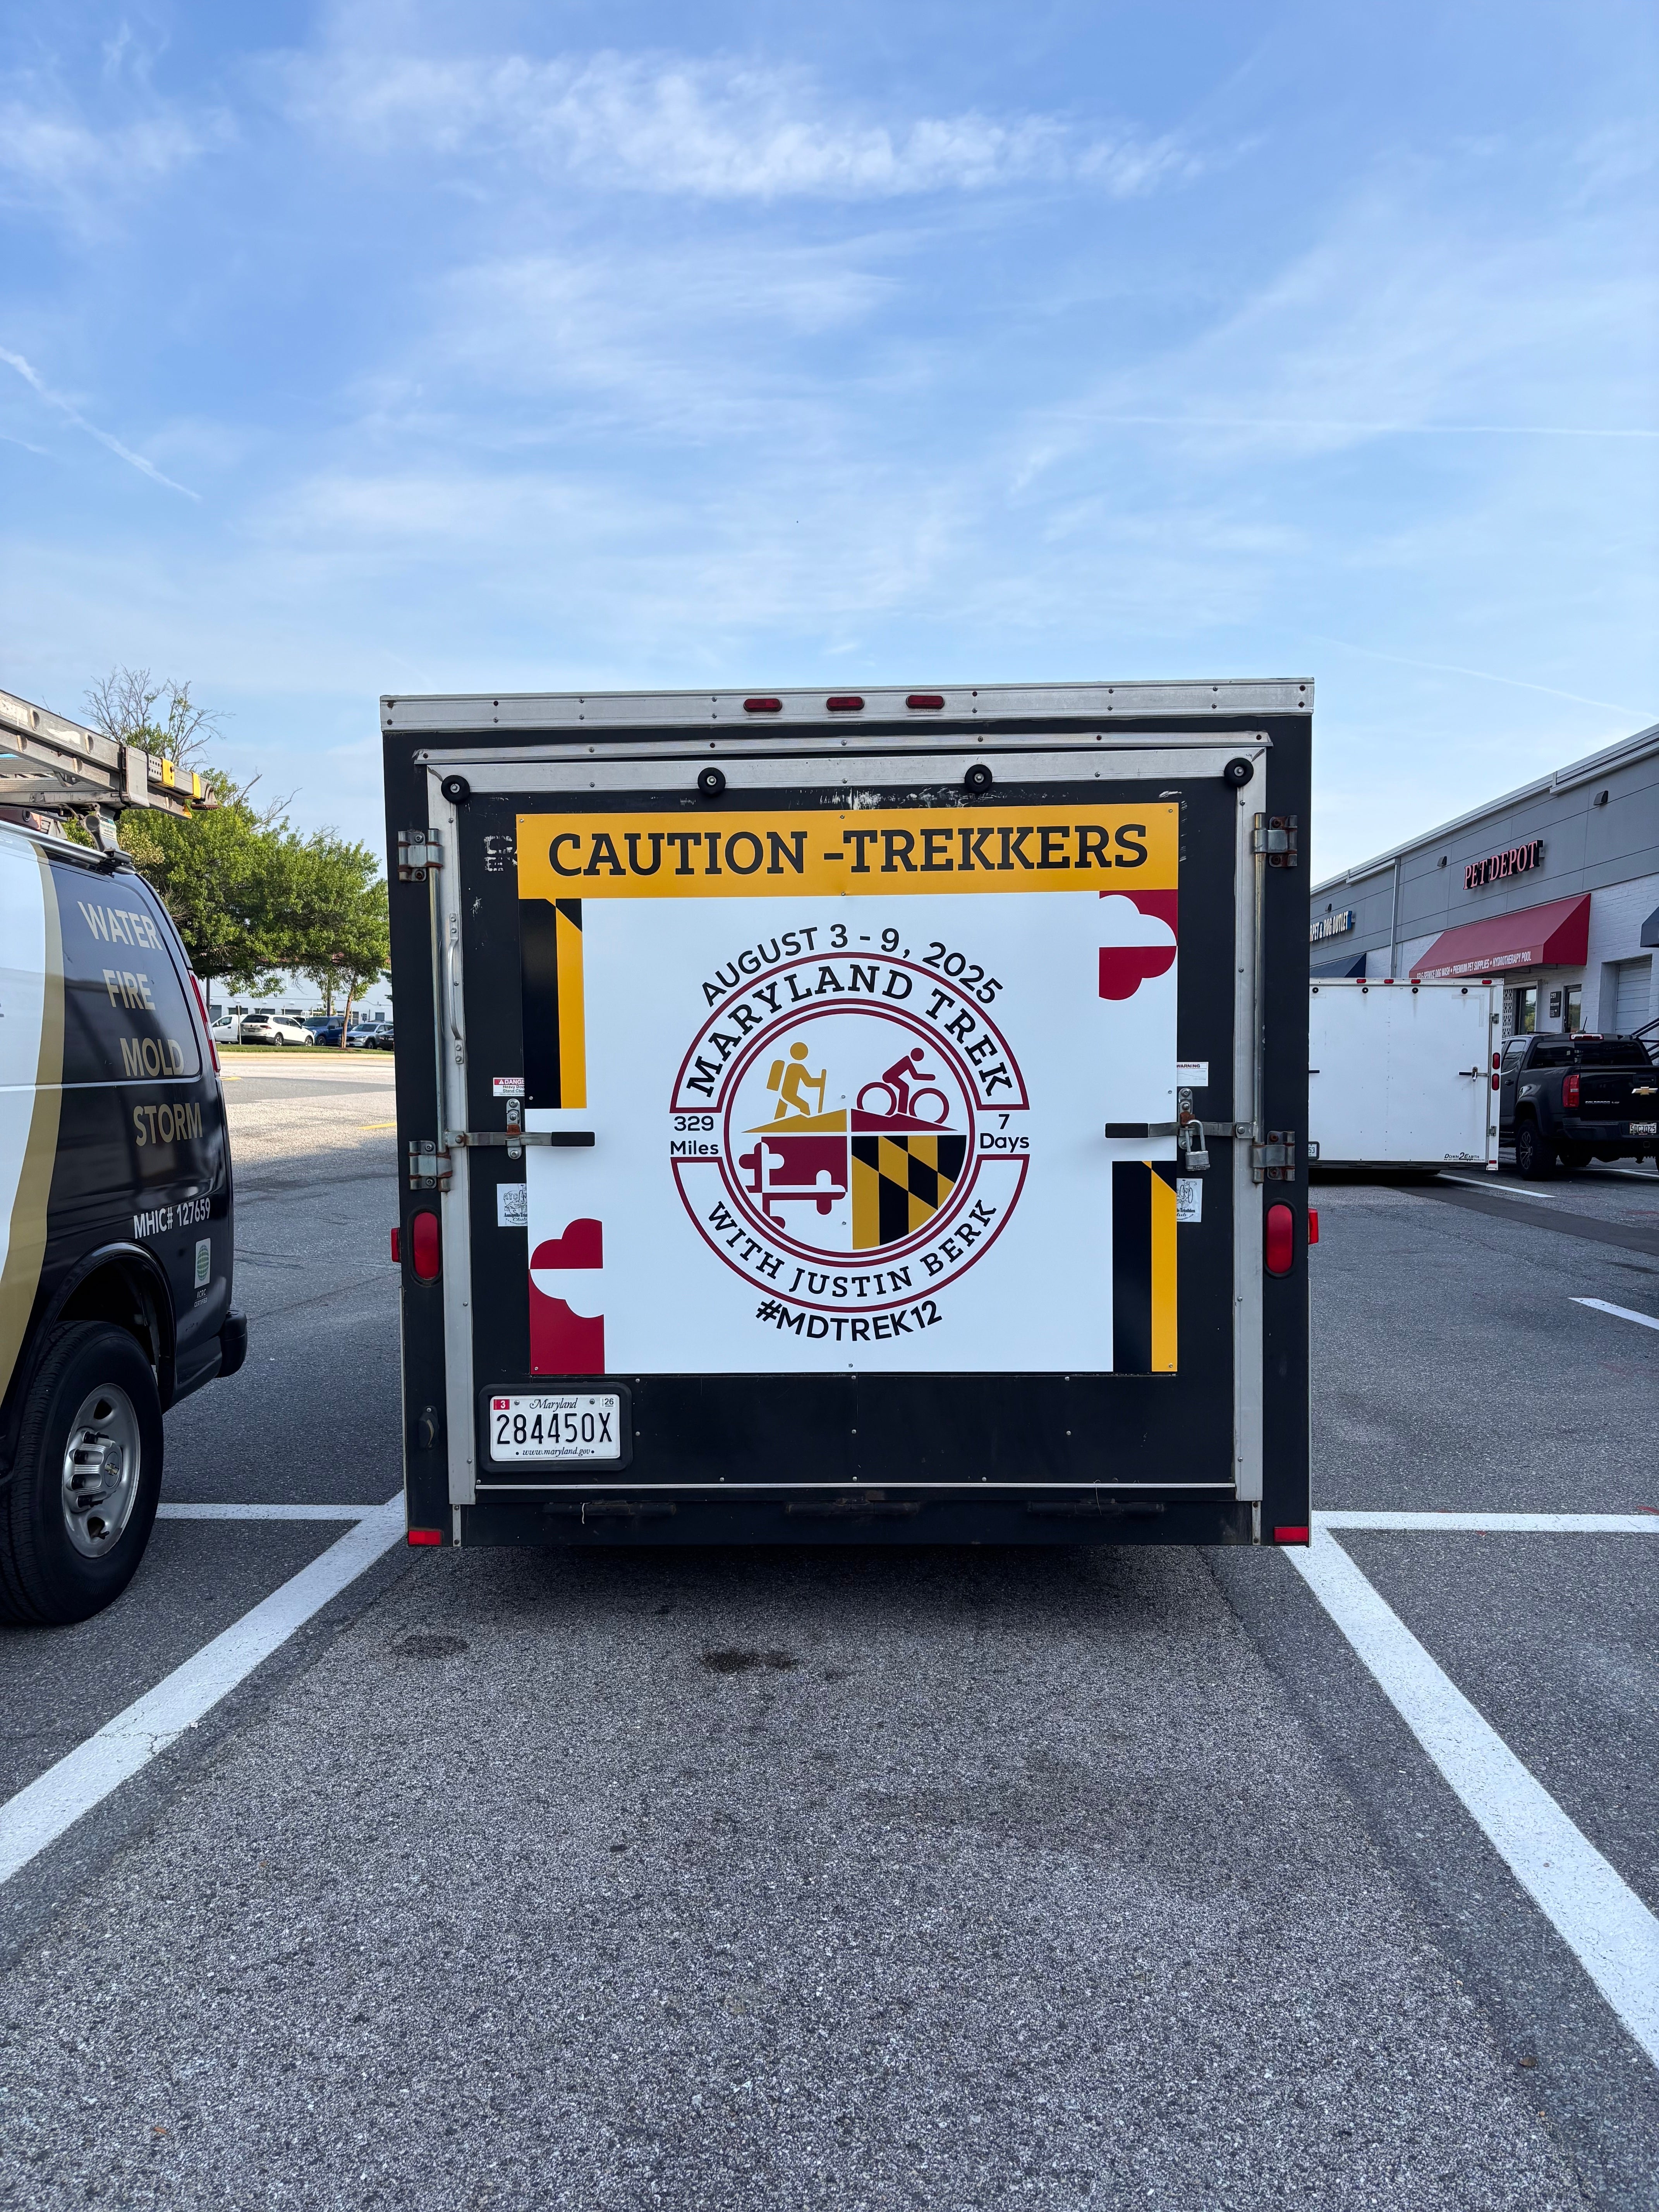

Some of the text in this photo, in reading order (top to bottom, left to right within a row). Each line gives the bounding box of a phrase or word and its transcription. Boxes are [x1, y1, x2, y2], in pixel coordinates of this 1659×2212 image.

[549, 831, 808, 877] CAUTION
[1463, 840, 1539, 890] PET DEPOT
[77, 901, 163, 951] WATER
[1319, 923, 1323, 939] &
[1323, 917, 1333, 938] RUG
[1332, 910, 1349, 935] OUTLET
[702, 926, 818, 1008] AUGUST
[830, 924, 848, 948] 3
[881, 927, 910, 959] 9,
[922, 941, 1003, 1004] 2025
[1474, 959, 1489, 970] SUPPLIES
[1492, 953, 1521, 967] HYDROTHERAPY
[1521, 951, 1531, 962] POOL
[102, 969, 156, 1010] FIRE
[686, 963, 1013, 1098] MARYLAND TREK
[120, 1037, 184, 1077] MOLD
[133, 1102, 203, 1147] STORM
[674, 1115, 714, 1132] 329
[998, 1113, 1010, 1130] 7
[670, 1140, 719, 1155] Miles
[980, 1132, 1030, 1153] Days
[133, 1197, 210, 1239] MHIC# 127659
[708, 1199, 997, 1298] WITH JUSTIN BERK
[755, 1299, 943, 1341] #MDTREK12
[500, 1400, 506, 1409] 3
[529, 1398, 579, 1412] Maryland
[496, 1412, 612, 1444] 284450X
[522, 1447, 590, 1457] www.maryland.gov
